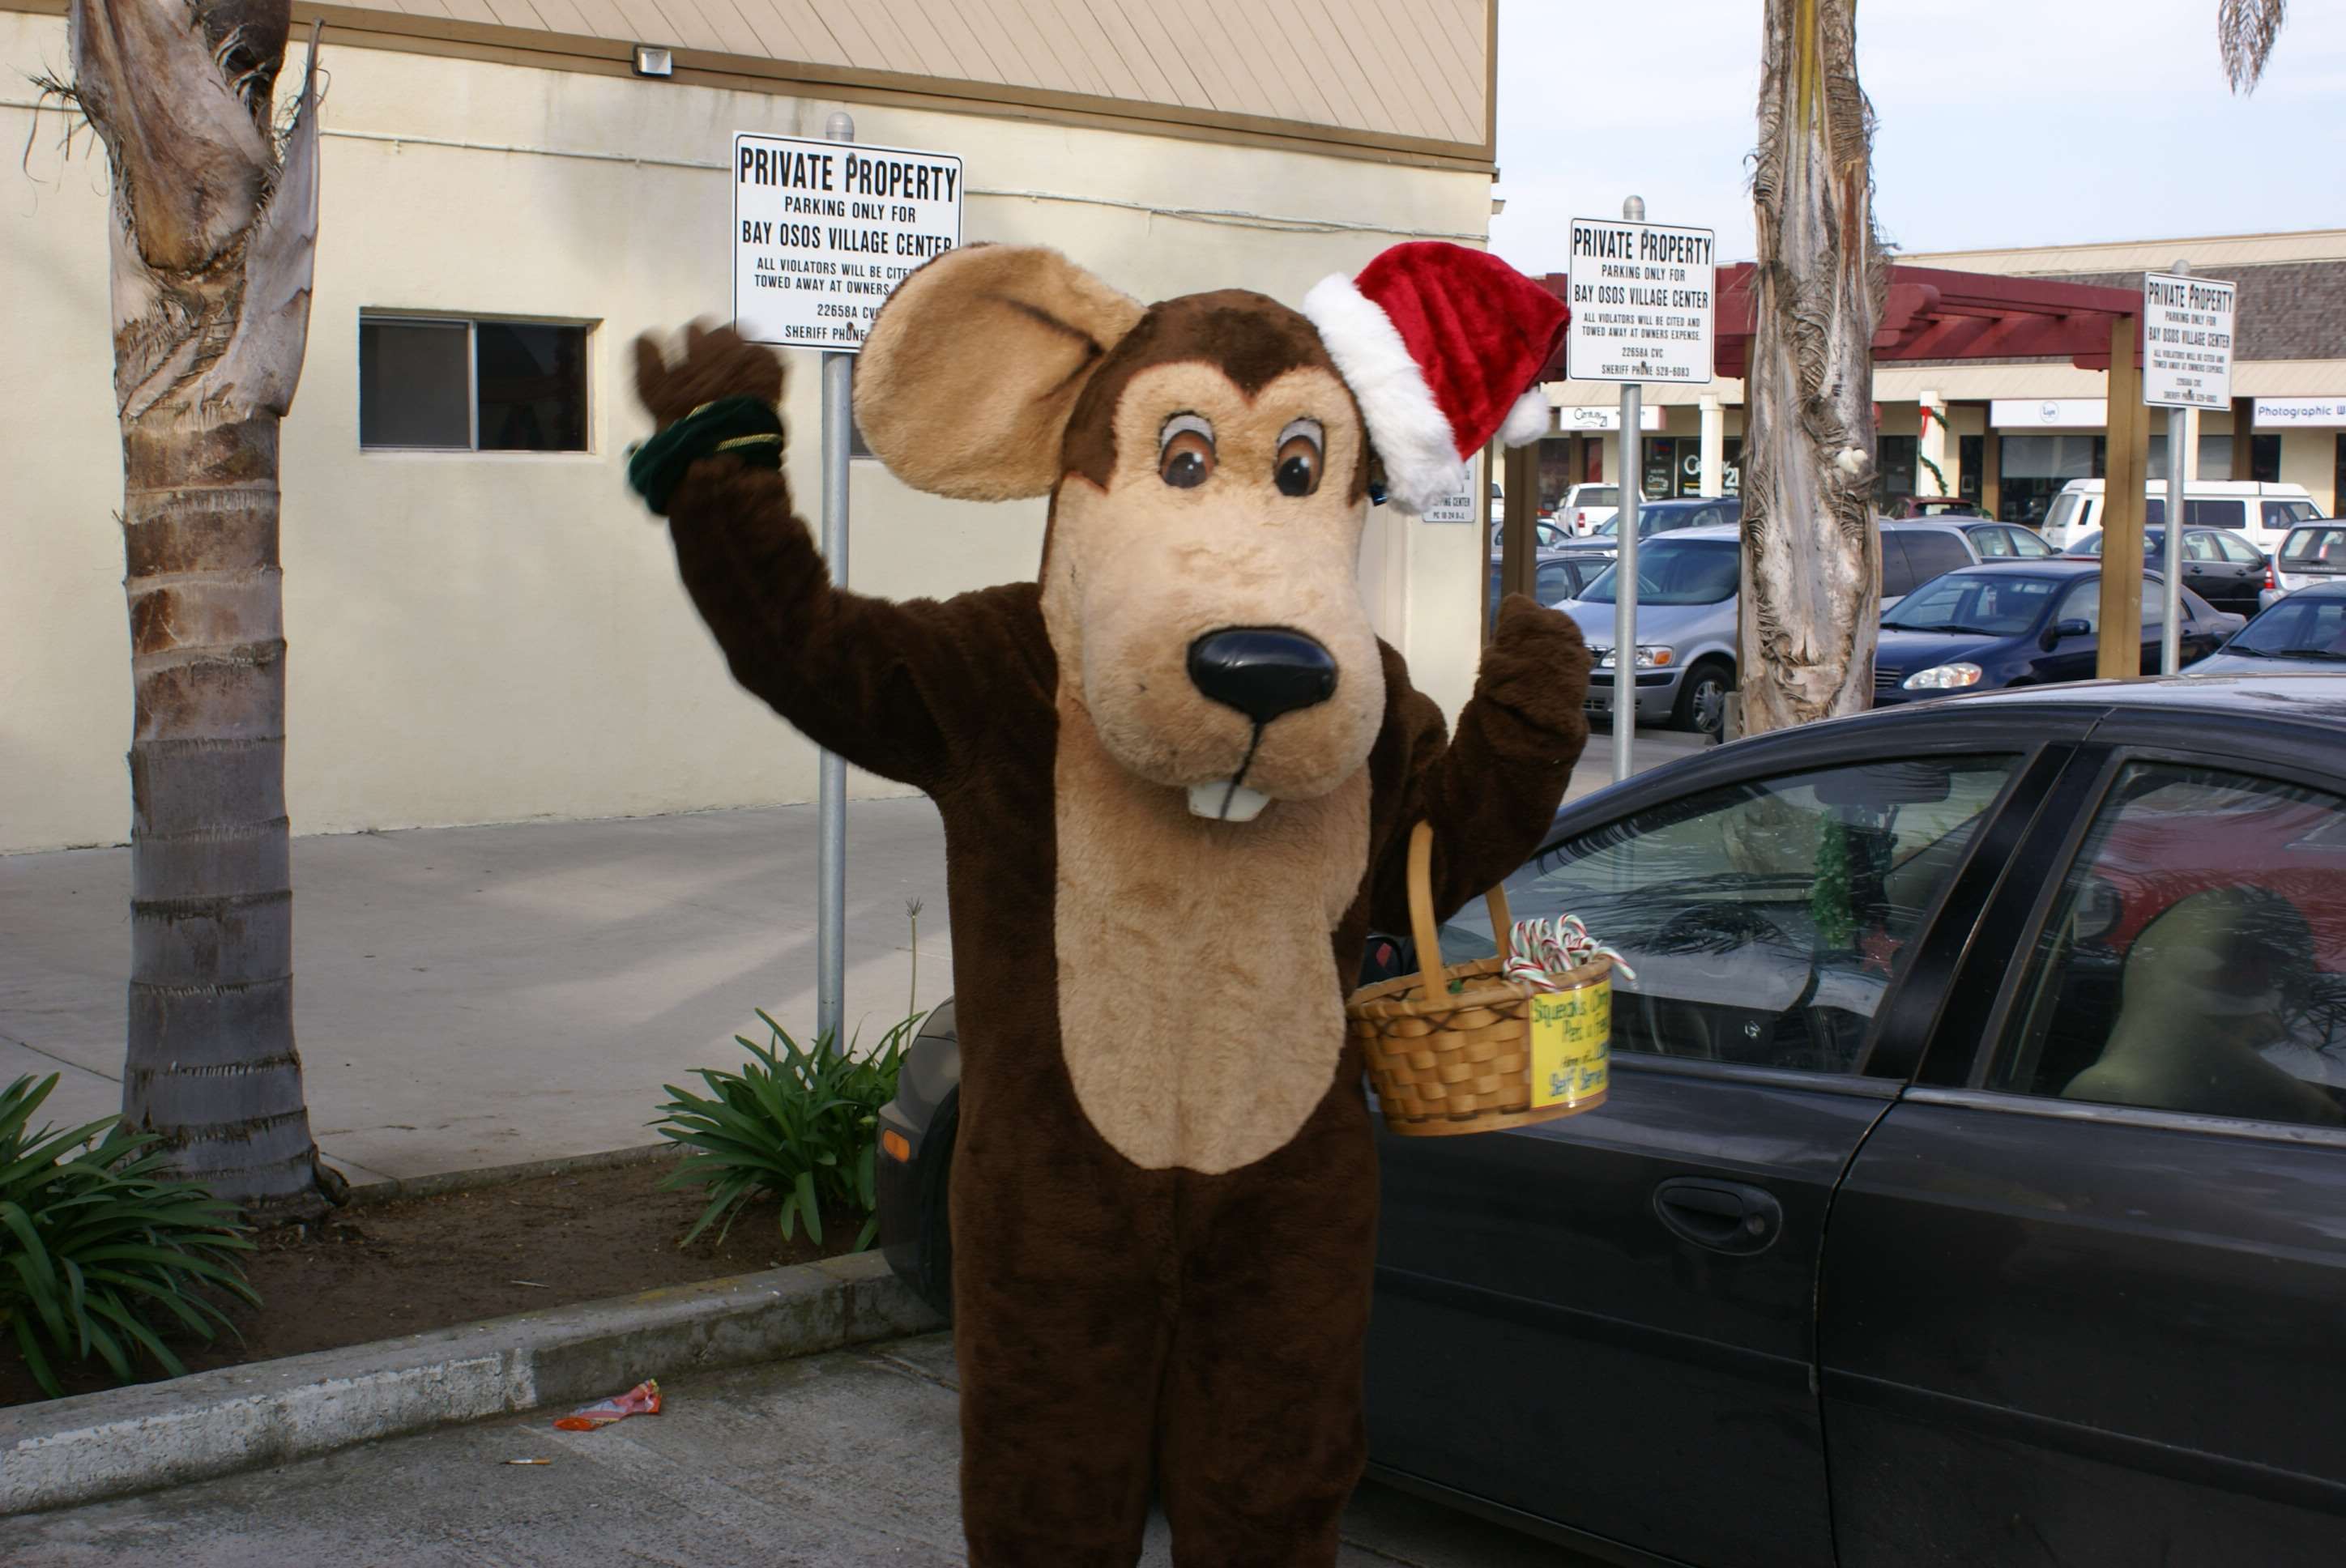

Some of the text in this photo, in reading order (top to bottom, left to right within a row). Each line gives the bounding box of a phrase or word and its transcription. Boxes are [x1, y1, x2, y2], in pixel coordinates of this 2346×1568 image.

[740, 147, 957, 202] PRIVATE PROPERTY
[785, 196, 915, 223] PARKING ONLY FOR
[743, 220, 952, 258] BAY OSOS VILLAGE CENTER
[1574, 228, 1711, 265] PRIVATE PROPERTY
[757, 258, 913, 279] ALL VIOLATORS WILL BE CITE
[1602, 264, 1685, 281] PARKING ONLY FOR
[755, 275, 889, 296] TOWED AWAY AT OWNERS
[1575, 284, 1708, 309] BAY OSOS VILLAGE CENTER
[2148, 282, 2233, 313] PRIVATE PROPERTY
[817, 304, 857, 318] 22658A
[1584, 313, 1700, 327] ALL VIOLATORS WILL BE CITED AND
[785, 326, 865, 342] SHERIFF PHONE
[1582, 326, 1606, 336] TOWED
[1608, 327, 1627, 337] AWAY
[1630, 329, 1638, 338] AT
[1641, 329, 1668, 339] OWNERS
[2148, 326, 2160, 341] BAY
[2182, 330, 2205, 346] VILLAGE
[1602, 364, 1629, 375] SHERIFF
[2259, 406, 2331, 419] Photographic
[1725, 467, 1739, 487] 21
